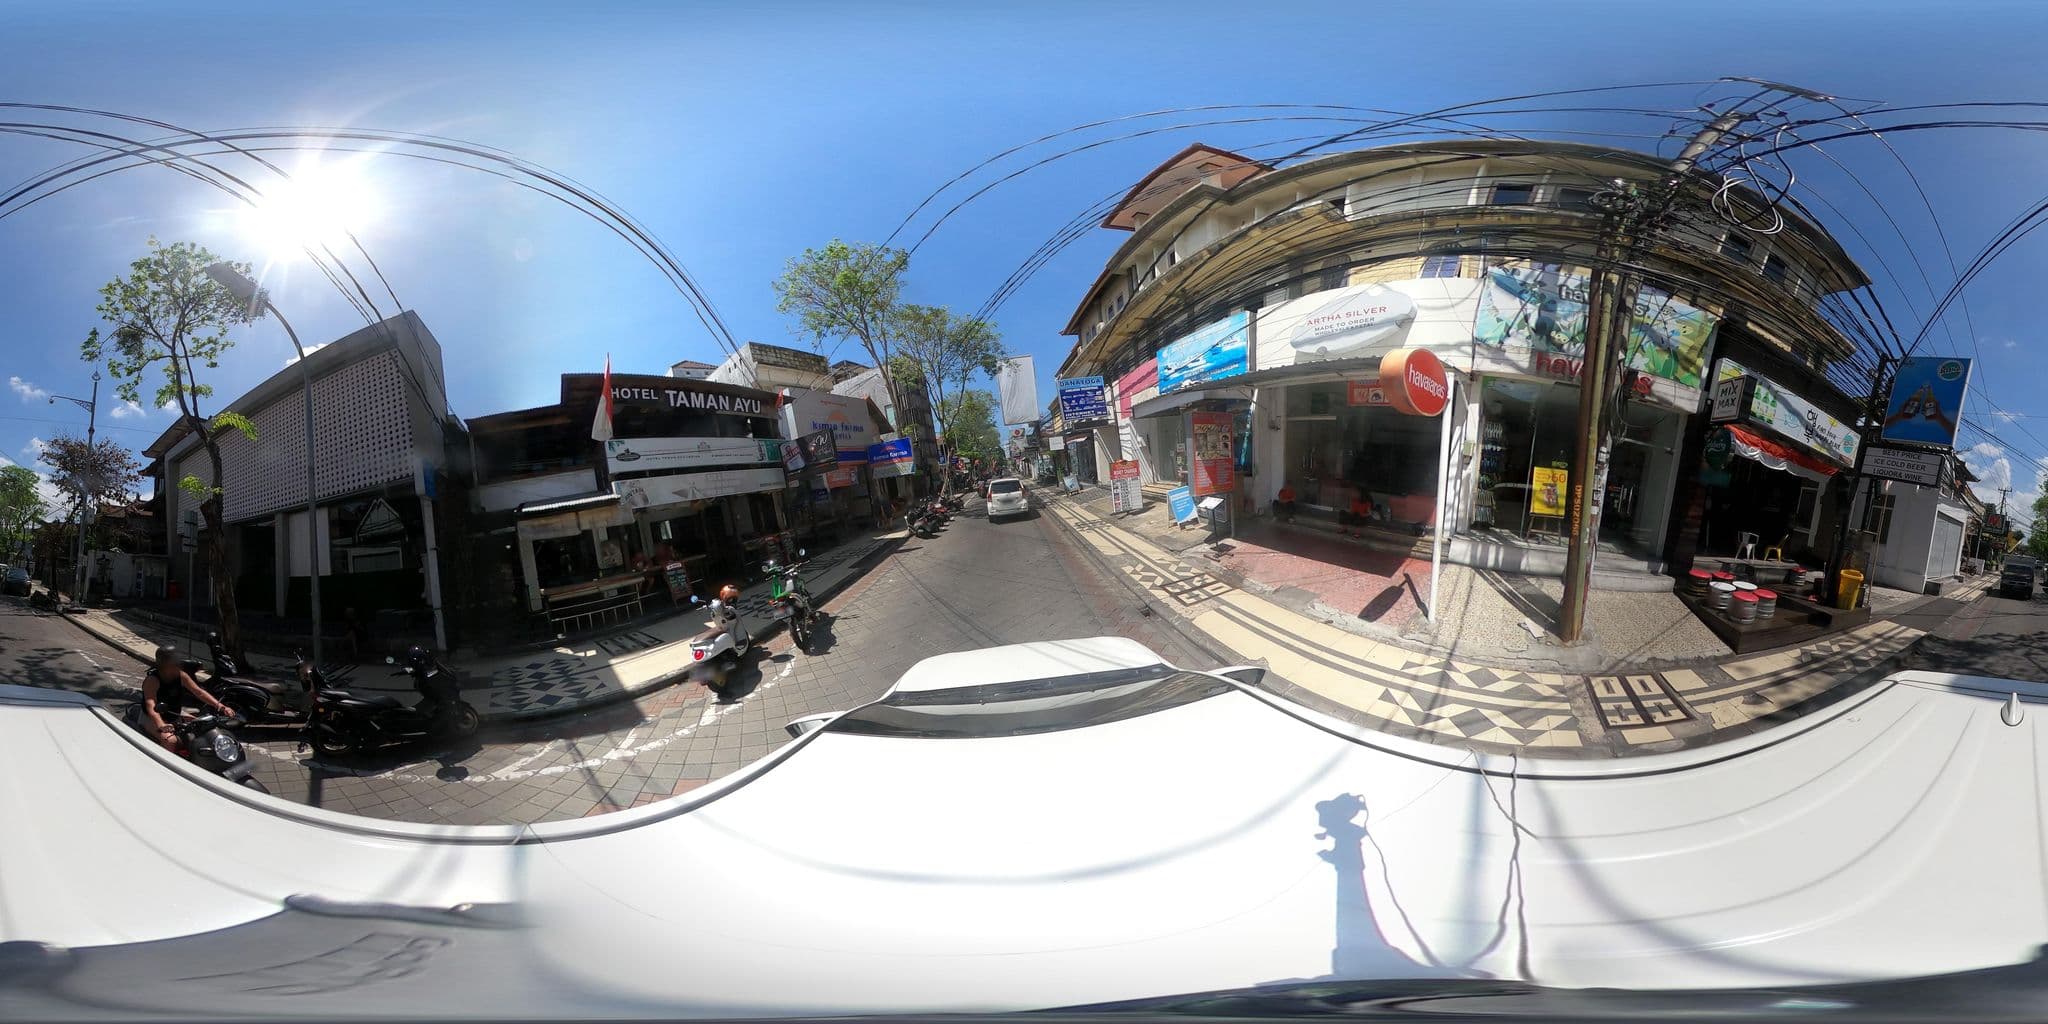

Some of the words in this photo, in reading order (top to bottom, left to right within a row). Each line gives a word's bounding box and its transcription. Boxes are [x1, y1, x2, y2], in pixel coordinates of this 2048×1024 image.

[1307, 314, 1342, 326] ARTHA
[1345, 306, 1387, 318] SILVER
[1408, 363, 1446, 399] havaianas
[1720, 380, 1739, 397] MIX
[610, 388, 659, 400] HOTEL
[665, 390, 729, 411] TAMAN
[733, 397, 761, 414] AYU
[1718, 397, 1737, 409] MAX
[1882, 448, 1900, 456] BEST
[1901, 451, 1921, 460] PRICE
[1873, 457, 1885, 465] ICE
[1886, 459, 1906, 468] COLD
[1906, 462, 1926, 472] BEER
[1904, 472, 1921, 481] WINE
